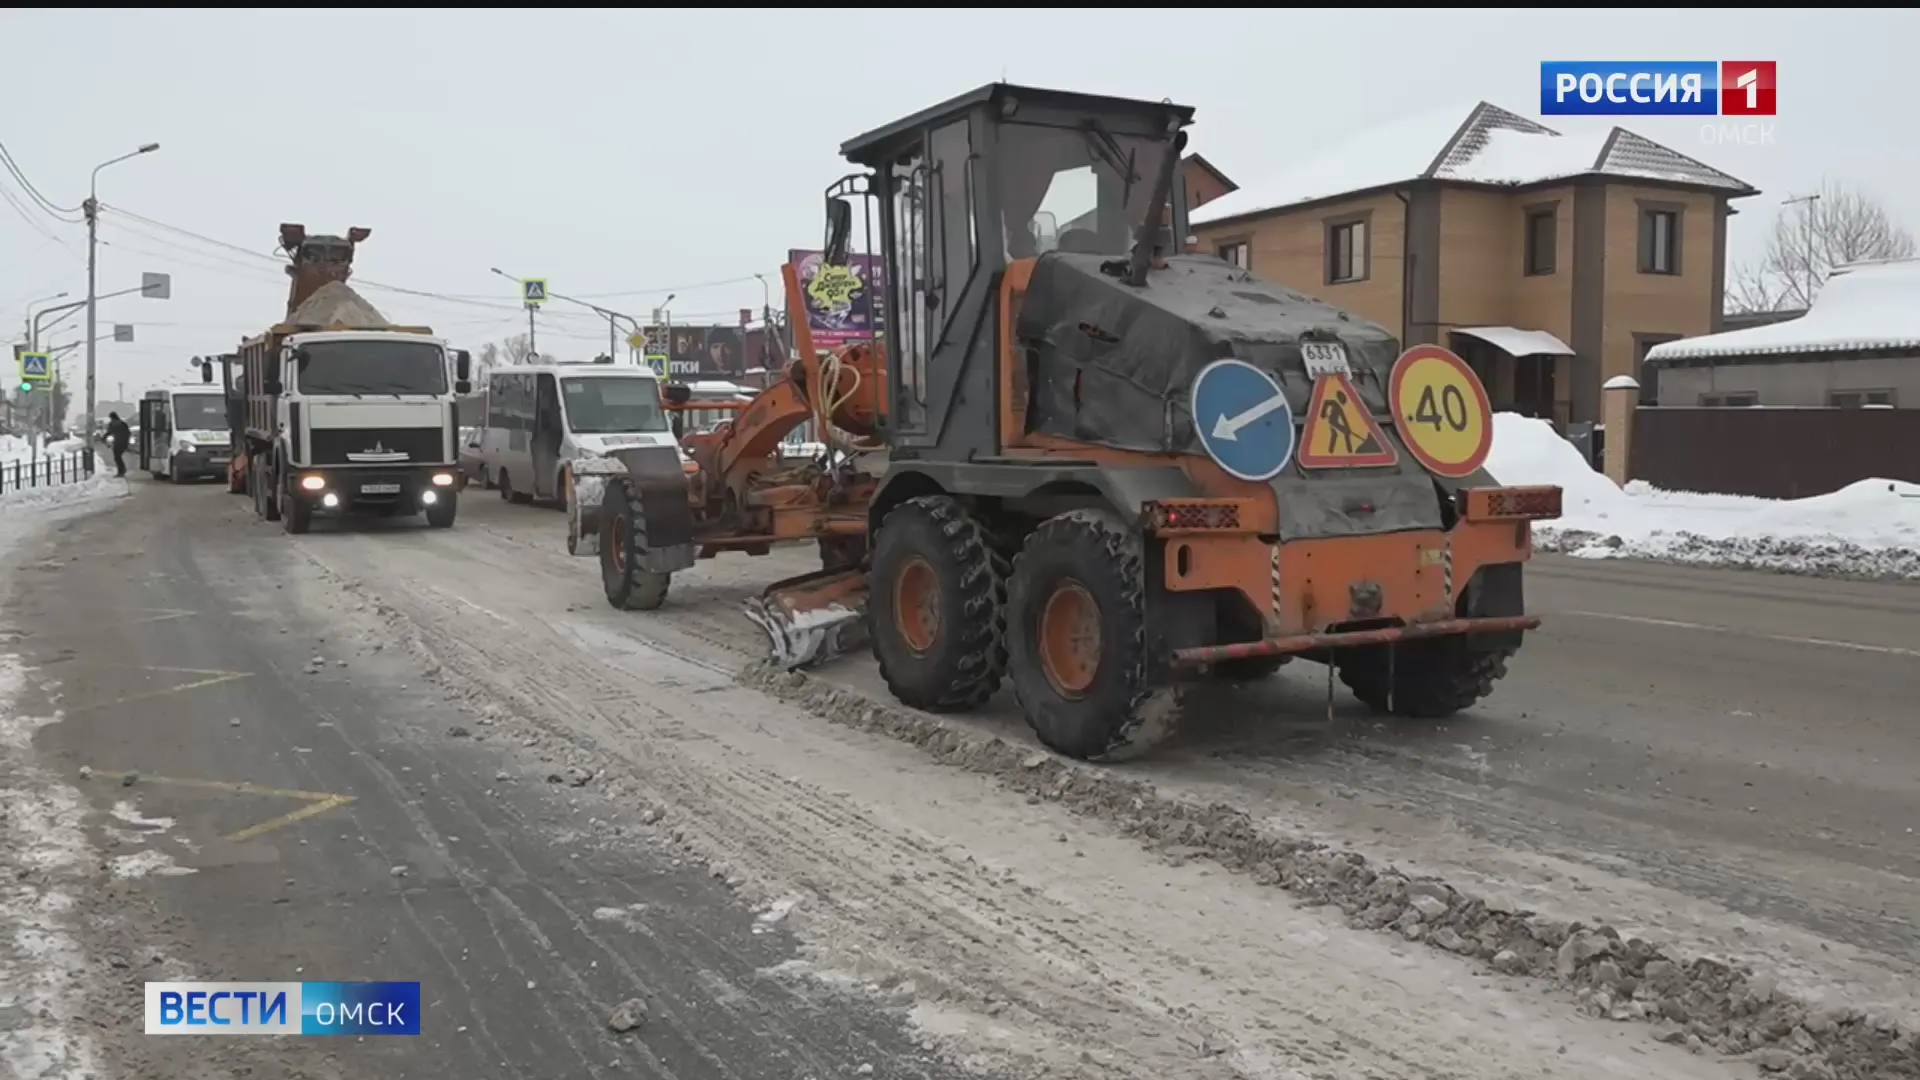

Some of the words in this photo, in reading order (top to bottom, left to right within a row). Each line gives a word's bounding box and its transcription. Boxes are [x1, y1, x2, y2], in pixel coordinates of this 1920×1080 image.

[1307, 345, 1341, 360] 6331
[670, 360, 700, 375] ТКИ
[1416, 384, 1467, 433] 40
